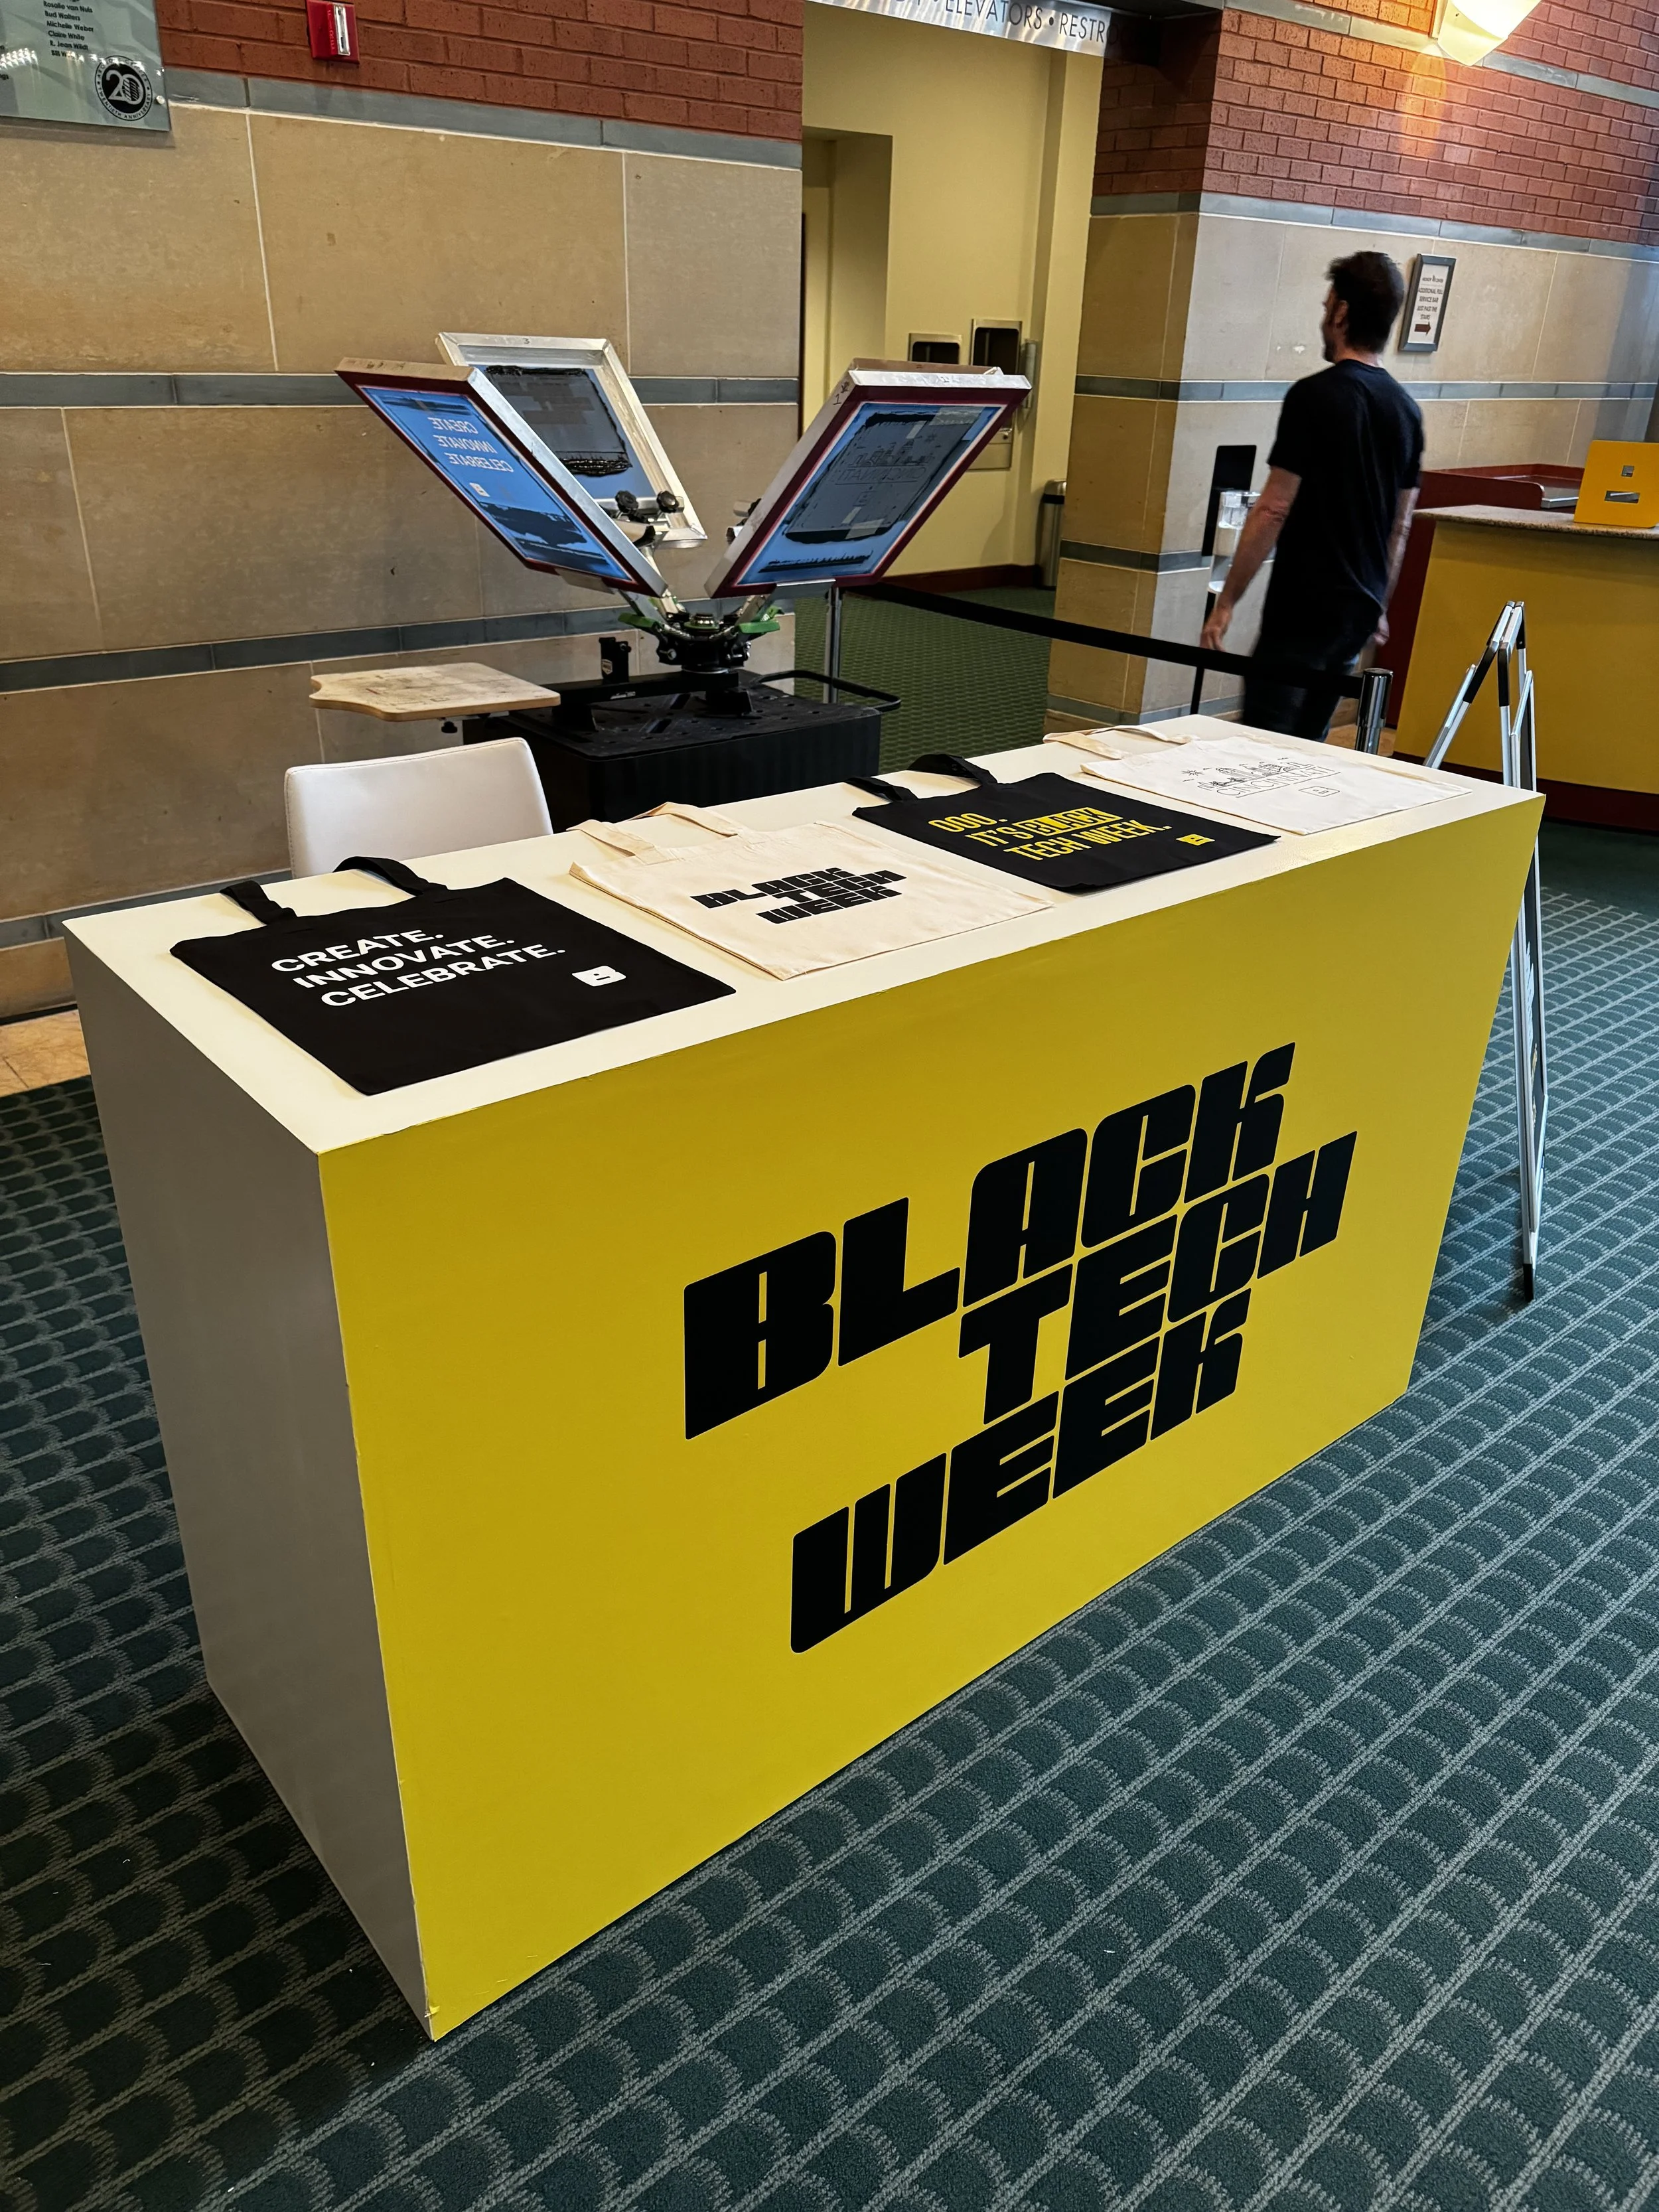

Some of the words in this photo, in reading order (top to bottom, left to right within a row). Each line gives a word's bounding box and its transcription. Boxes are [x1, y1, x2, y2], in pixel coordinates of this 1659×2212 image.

[945, 0, 1043, 30] ELEVATORS
[1217, 766, 1335, 796] CINCINNATI
[965, 826, 1034, 847] IT'S
[1015, 807, 1121, 836] BLACK
[1003, 836, 1092, 861] TECH
[1075, 820, 1173, 845] WEEK.
[689, 867, 856, 909] BLACK
[755, 885, 902, 924] WEEK
[772, 869, 907, 903] TECH
[271, 929, 444, 972] CREATE.
[293, 934, 515, 988] INNOVATE.
[321, 944, 566, 1006] CELEBRATE.
[684, 1041, 1295, 1440] BLACK
[958, 1130, 1358, 1425] TECH
[790, 1288, 1252, 1653] WEEK
